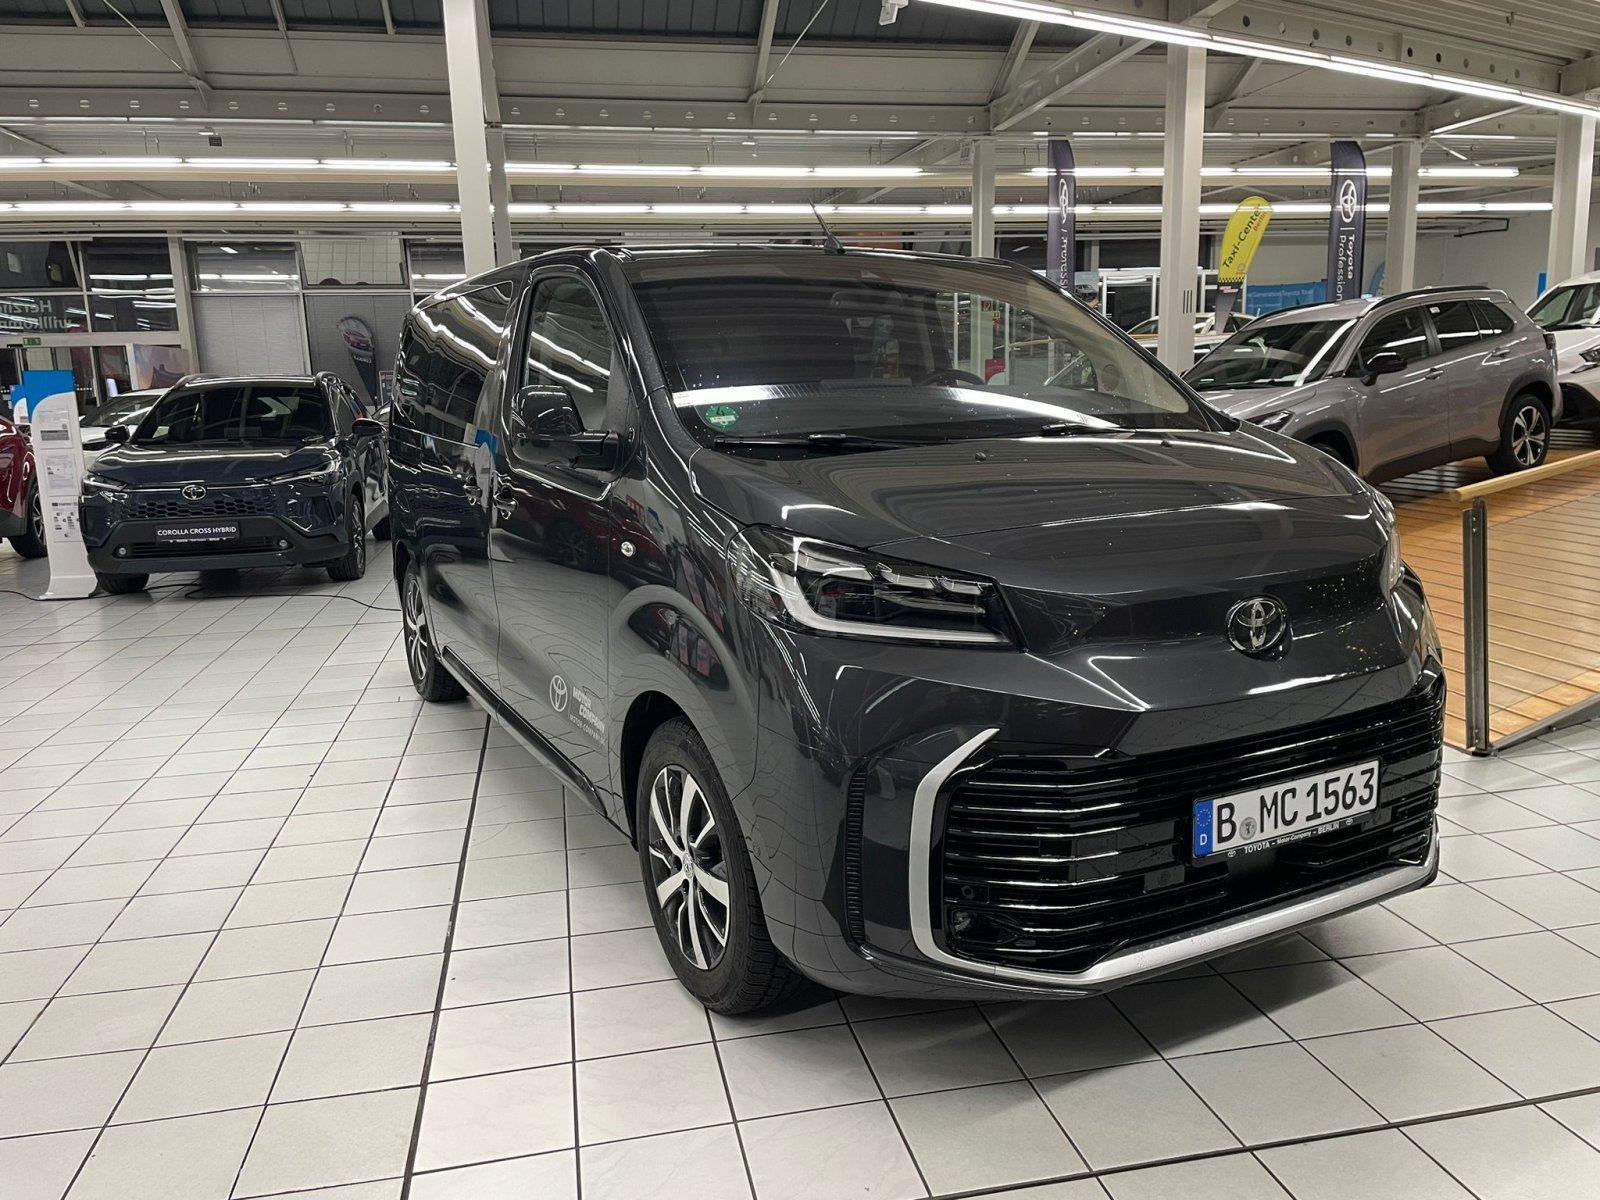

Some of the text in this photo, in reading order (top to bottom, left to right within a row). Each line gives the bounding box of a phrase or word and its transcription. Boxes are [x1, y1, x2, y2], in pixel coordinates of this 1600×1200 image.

[1222, 204, 1261, 268] Taxi-Cente
[1347, 234, 1355, 279] Toyota
[1217, 768, 1374, 843] B MC 1563
[1199, 834, 1207, 846] D
[1244, 841, 1270, 854] TOYOTA
[1317, 823, 1340, 835] BERLIN
